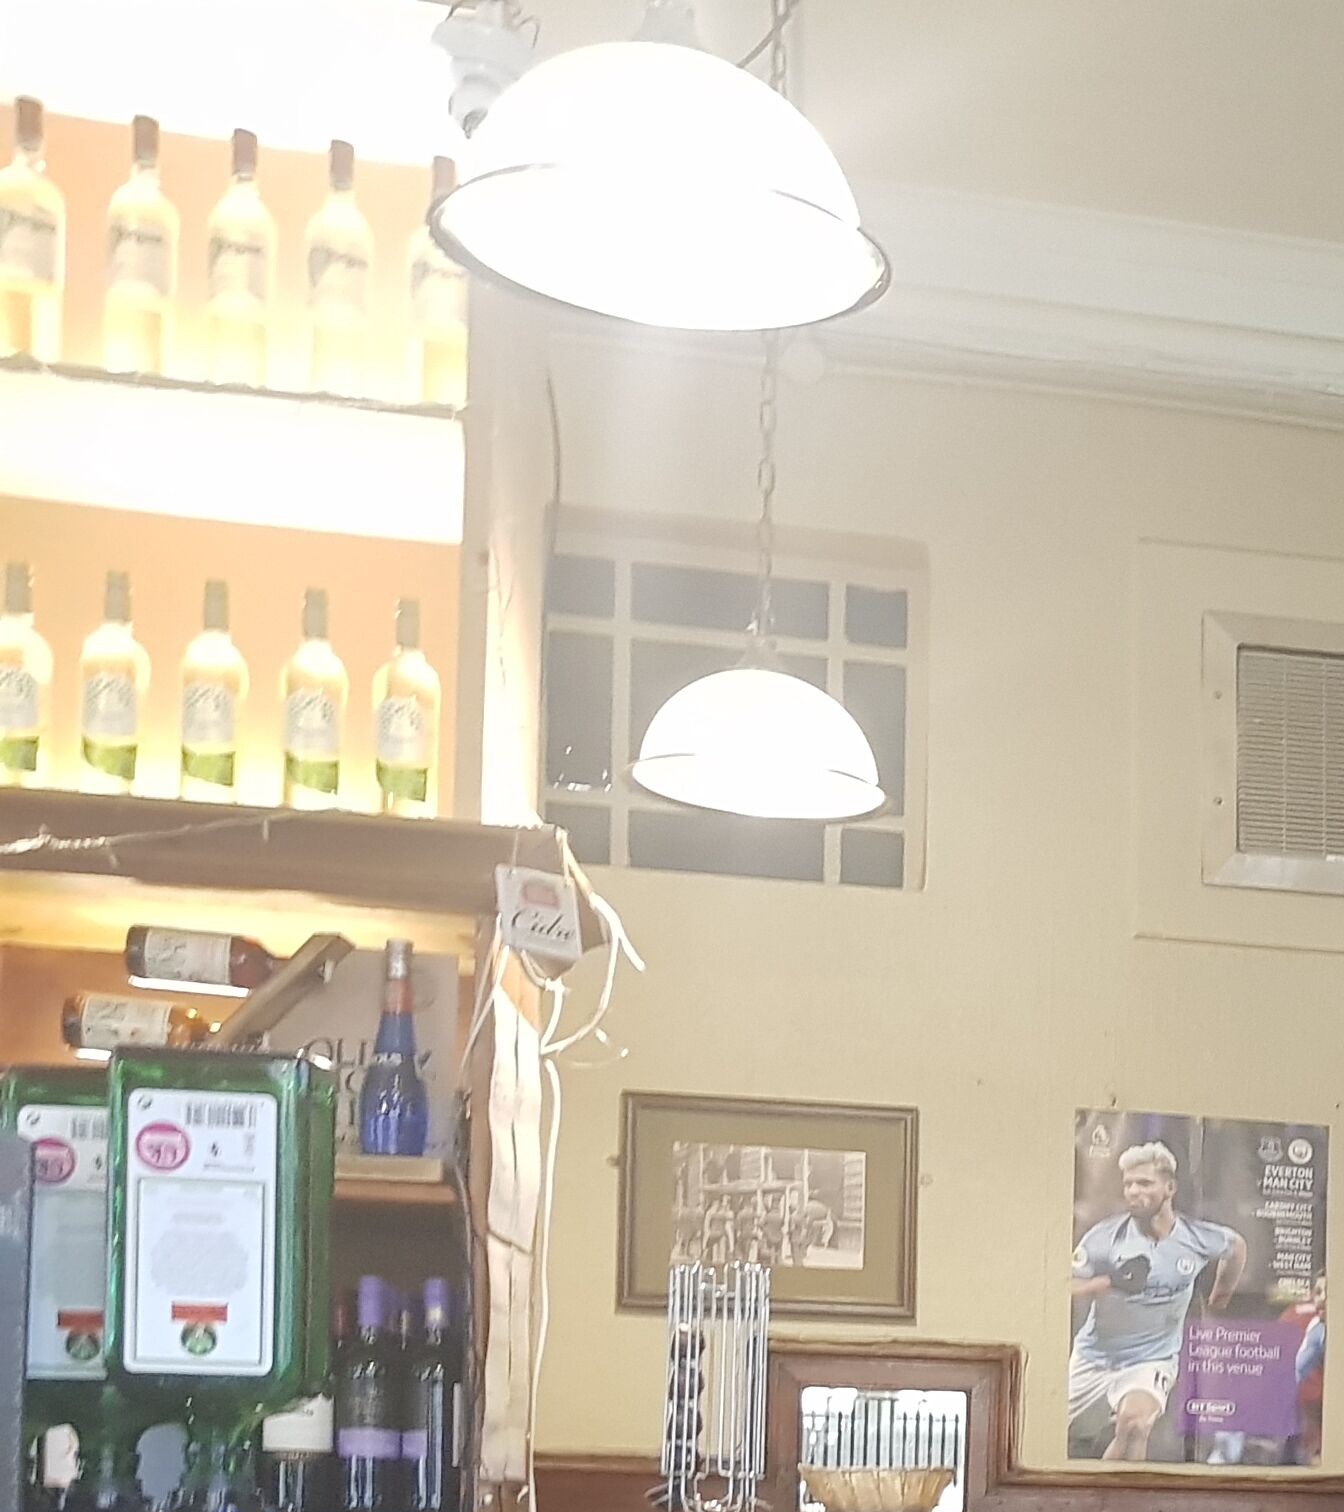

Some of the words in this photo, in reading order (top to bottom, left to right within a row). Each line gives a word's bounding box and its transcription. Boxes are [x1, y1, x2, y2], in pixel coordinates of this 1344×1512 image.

[1265, 1164, 1313, 1179] EVERTON
[1263, 1177, 1288, 1189] MAN
[1289, 1178, 1313, 1190] CITY
[1189, 1325, 1213, 1340] Live
[1216, 1326, 1261, 1342] Premier
[1189, 1342, 1233, 1359] League
[1235, 1343, 1280, 1360] football
[1202, 1360, 1224, 1374] this
[1227, 1363, 1264, 1376] venue
